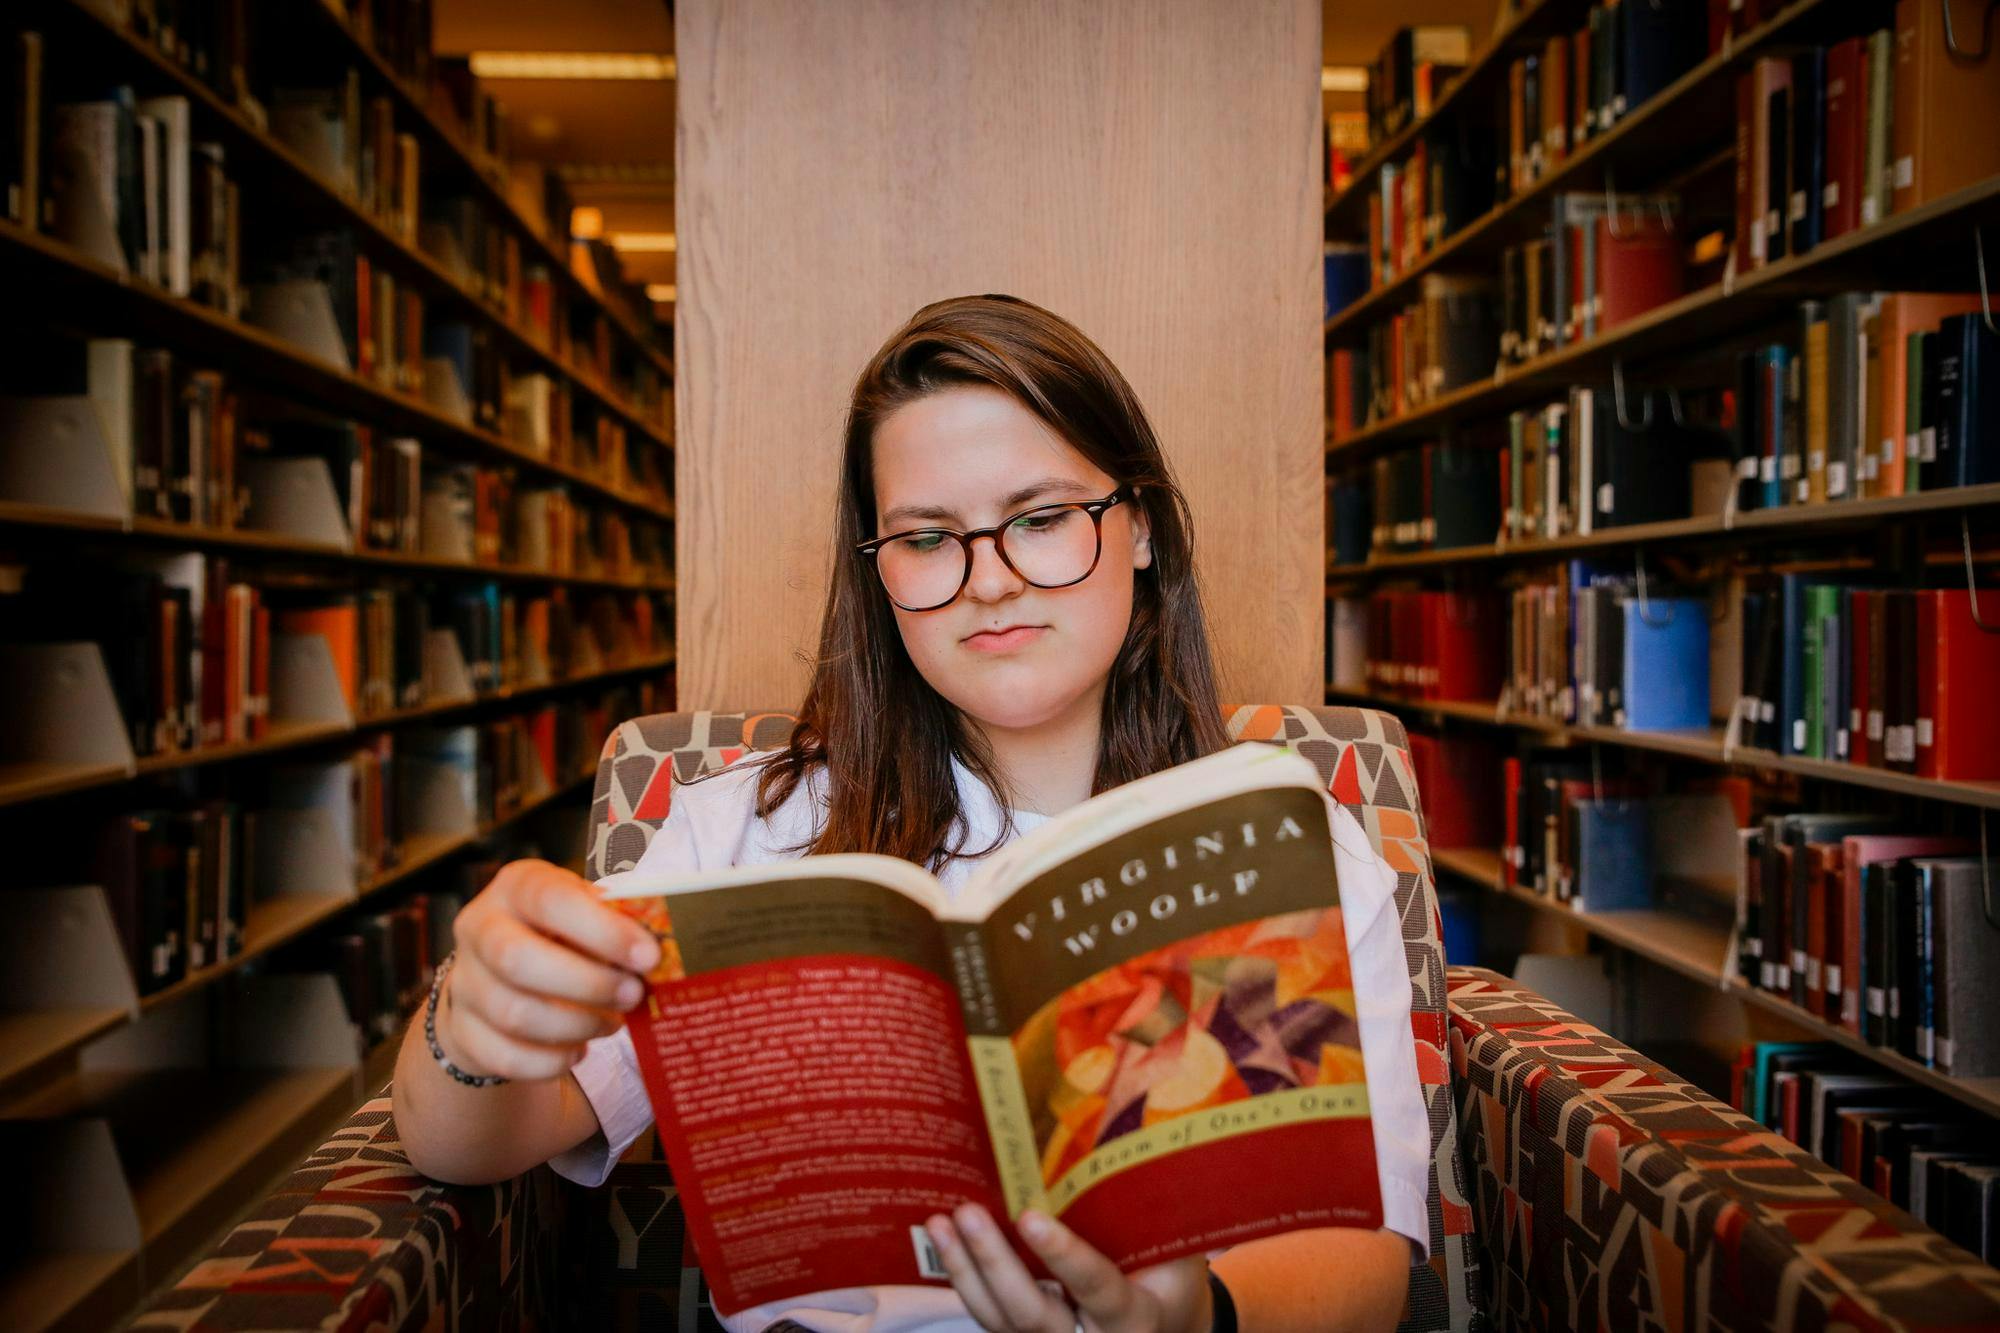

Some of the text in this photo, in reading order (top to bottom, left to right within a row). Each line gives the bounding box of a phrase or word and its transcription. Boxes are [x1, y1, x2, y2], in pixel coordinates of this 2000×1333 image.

[1014, 816, 1303, 942] VIRGINIA
[1065, 869, 1259, 956] WOOLF
[1088, 1139, 1151, 1175] Room
[1169, 1122, 1194, 1144] of
[1210, 1101, 1283, 1131] One's
[1301, 1094, 1357, 1112] Own
